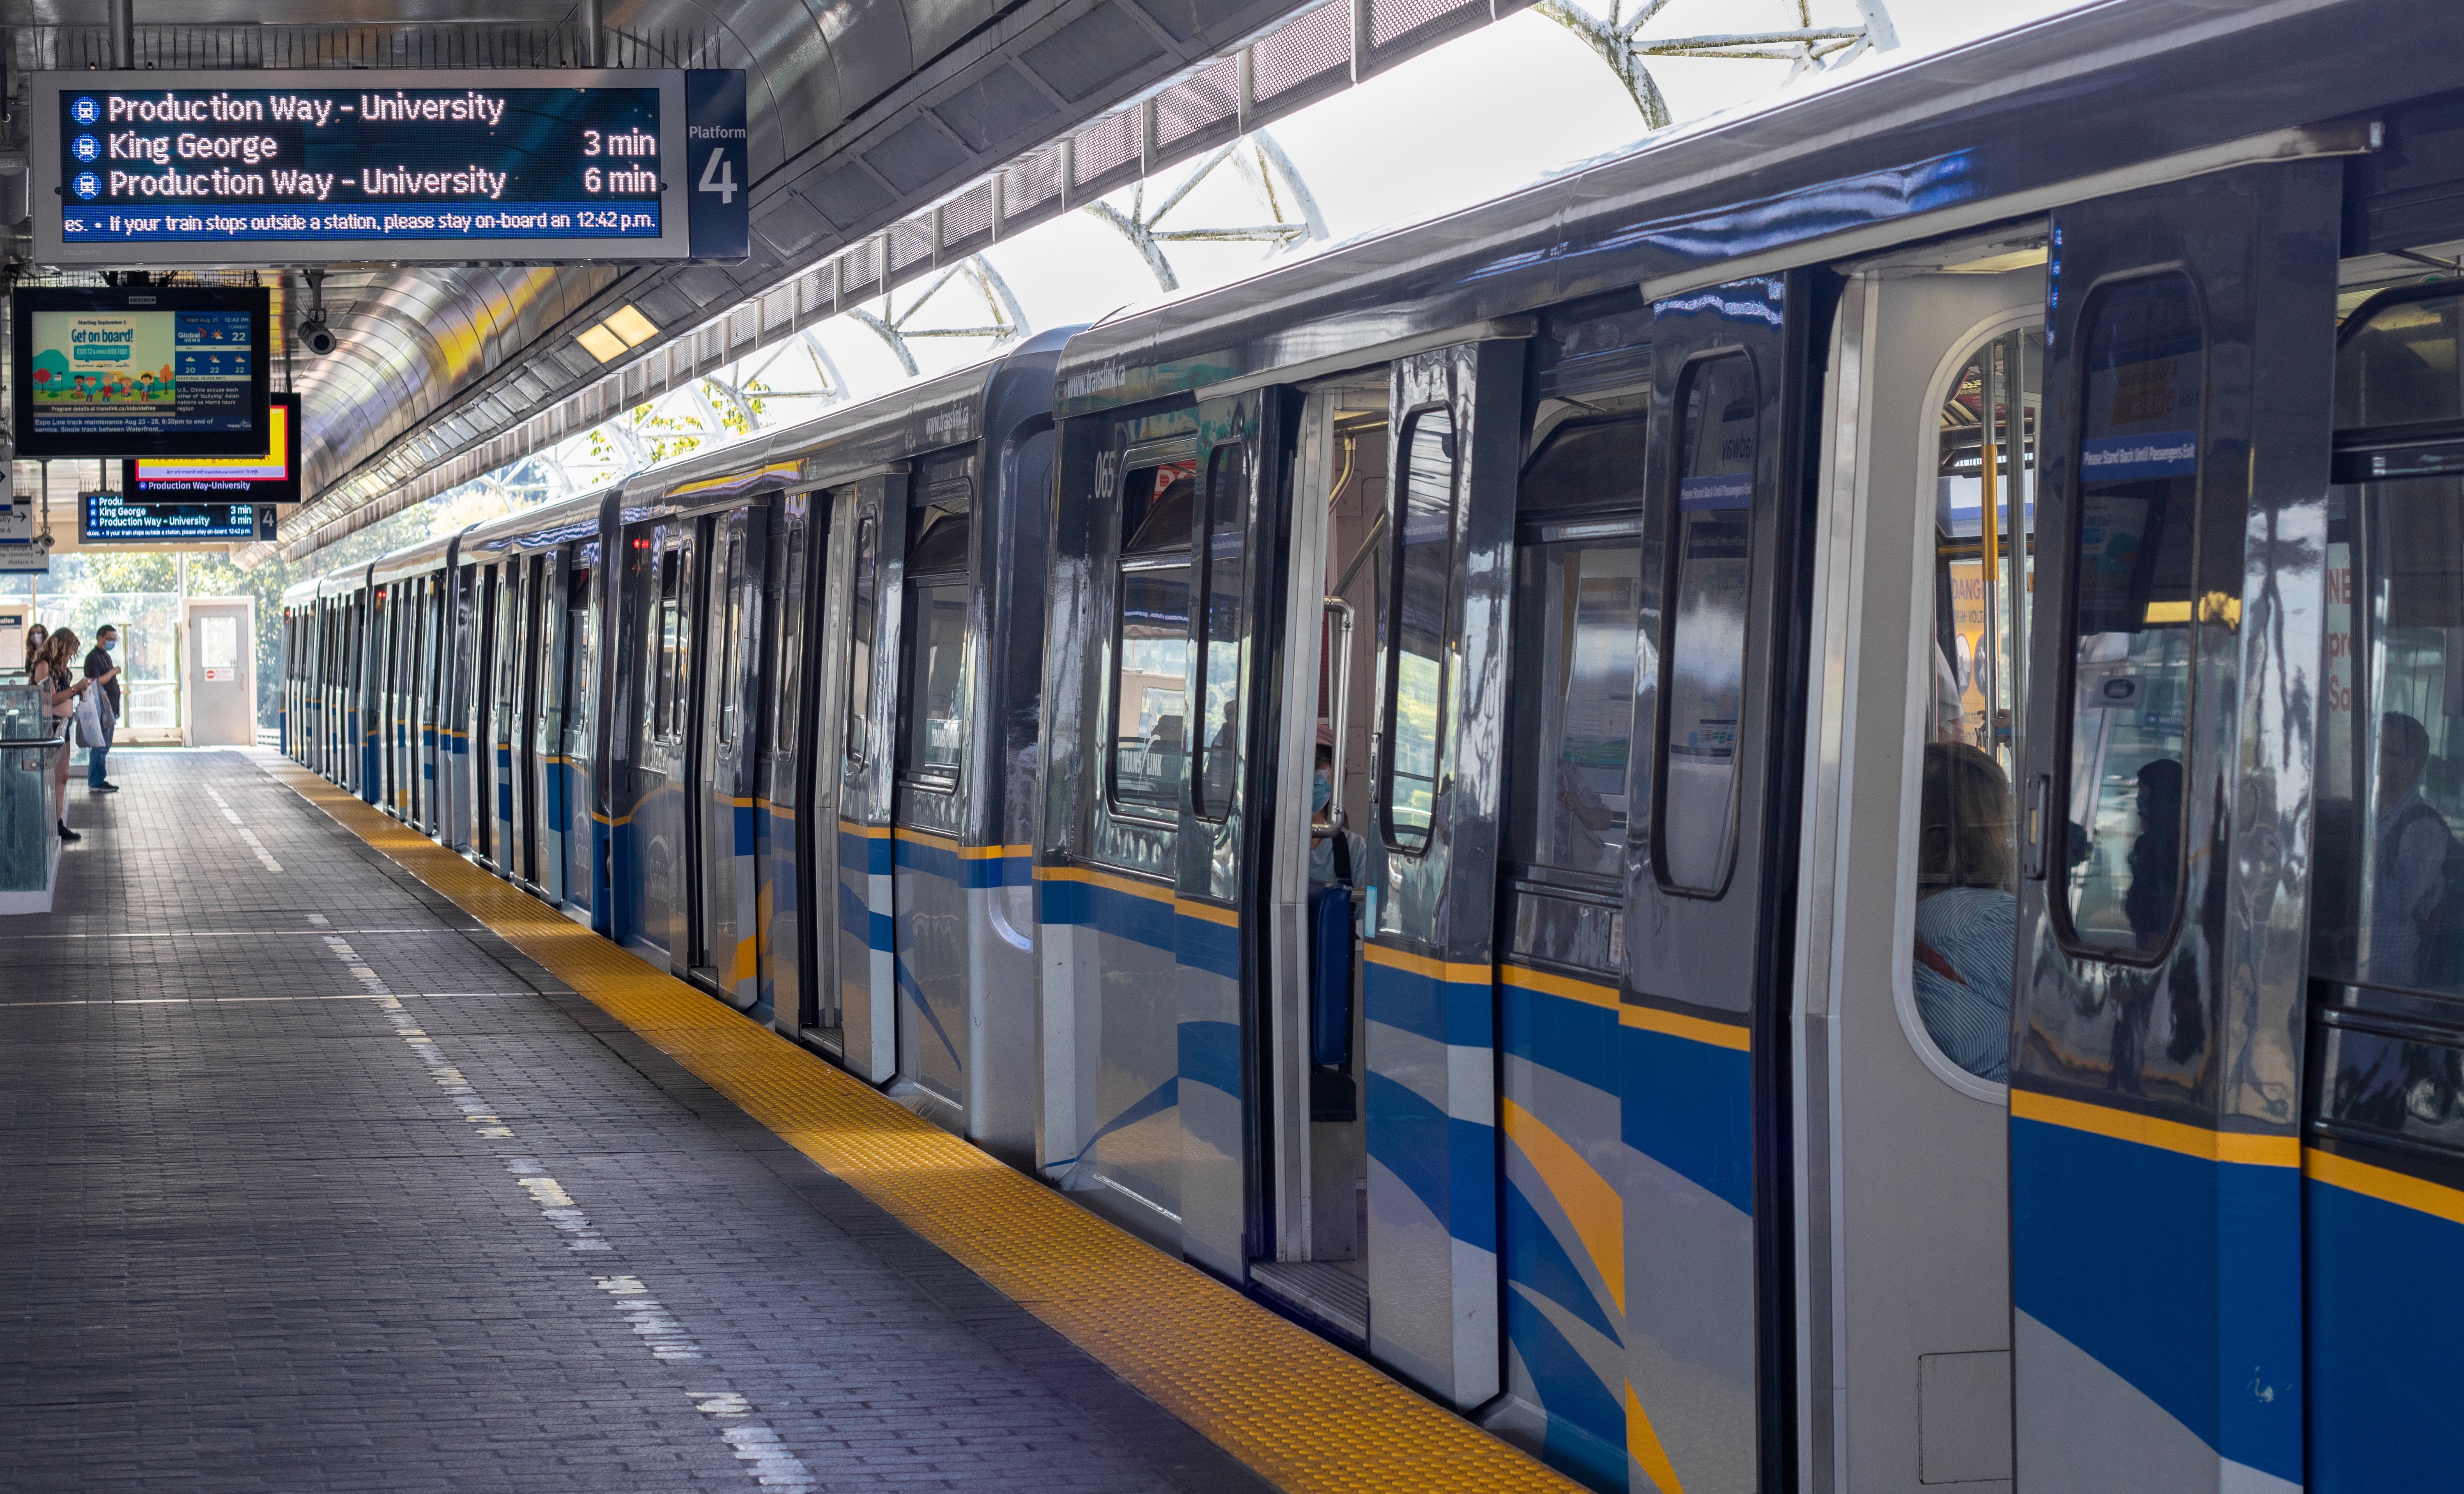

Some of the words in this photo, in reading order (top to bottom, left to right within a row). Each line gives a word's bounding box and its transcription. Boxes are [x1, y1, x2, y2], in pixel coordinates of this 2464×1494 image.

[108, 93, 262, 121] Production
[269, 96, 331, 126] Way
[361, 92, 504, 125] University
[584, 131, 600, 156] 3
[609, 128, 656, 156] min
[690, 126, 746, 138] Platform
[110, 131, 170, 164] King
[177, 133, 277, 163] George
[110, 168, 264, 195] Production
[271, 170, 333, 200] Way
[363, 165, 506, 198] University
[585, 168, 601, 192] 6
[609, 165, 656, 192] min
[699, 148, 738, 204] 4
[65, 218, 88, 232] es.
[110, 216, 121, 231] If
[124, 218, 161, 235] your
[165, 215, 202, 231] train
[205, 216, 248, 235] stops
[251, 214, 307, 230] outside
[310, 218, 321, 230] a
[324, 214, 381, 230] station,
[384, 213, 434, 233] please
[439, 213, 471, 232] stay
[476, 212, 547, 228] on-board
[551, 216, 570, 228] an
[577, 211, 617, 228] 12:42
[621, 215, 655, 232] p.m.
[71, 329, 87, 343] Get
[88, 331, 100, 342] on
[102, 328, 133, 342] board!
[232, 332, 246, 341] 22
[1068, 359, 1126, 399] www.translink.ca
[926, 401, 969, 435] www.translink.ca
[2083, 451, 2101, 466] Please
[2102, 448, 2119, 465] Stand
[2119, 447, 2133, 463] Back
[2134, 446, 2148, 462] Until
[2149, 446, 2182, 463] Passengers
[2183, 443, 2195, 458] Exit
[149, 481, 191, 489] Production
[193, 480, 251, 490] Way-University
[1095, 451, 1115, 499] 065
[99, 507, 116, 517] King
[118, 508, 146, 517] George
[230, 505, 236, 514] 3
[237, 504, 252, 514] min
[231, 516, 236, 525] 6
[237, 515, 252, 524] min
[262, 510, 274, 527] 4
[99, 517, 143, 526] Production
[144, 517, 162, 527] Way
[169, 515, 210, 527] University
[1954, 610, 1966, 623] IGH
[1968, 610, 1984, 623] VOLT
[1122, 750, 1142, 774] TRANS
[1147, 752, 1163, 777] LINK
